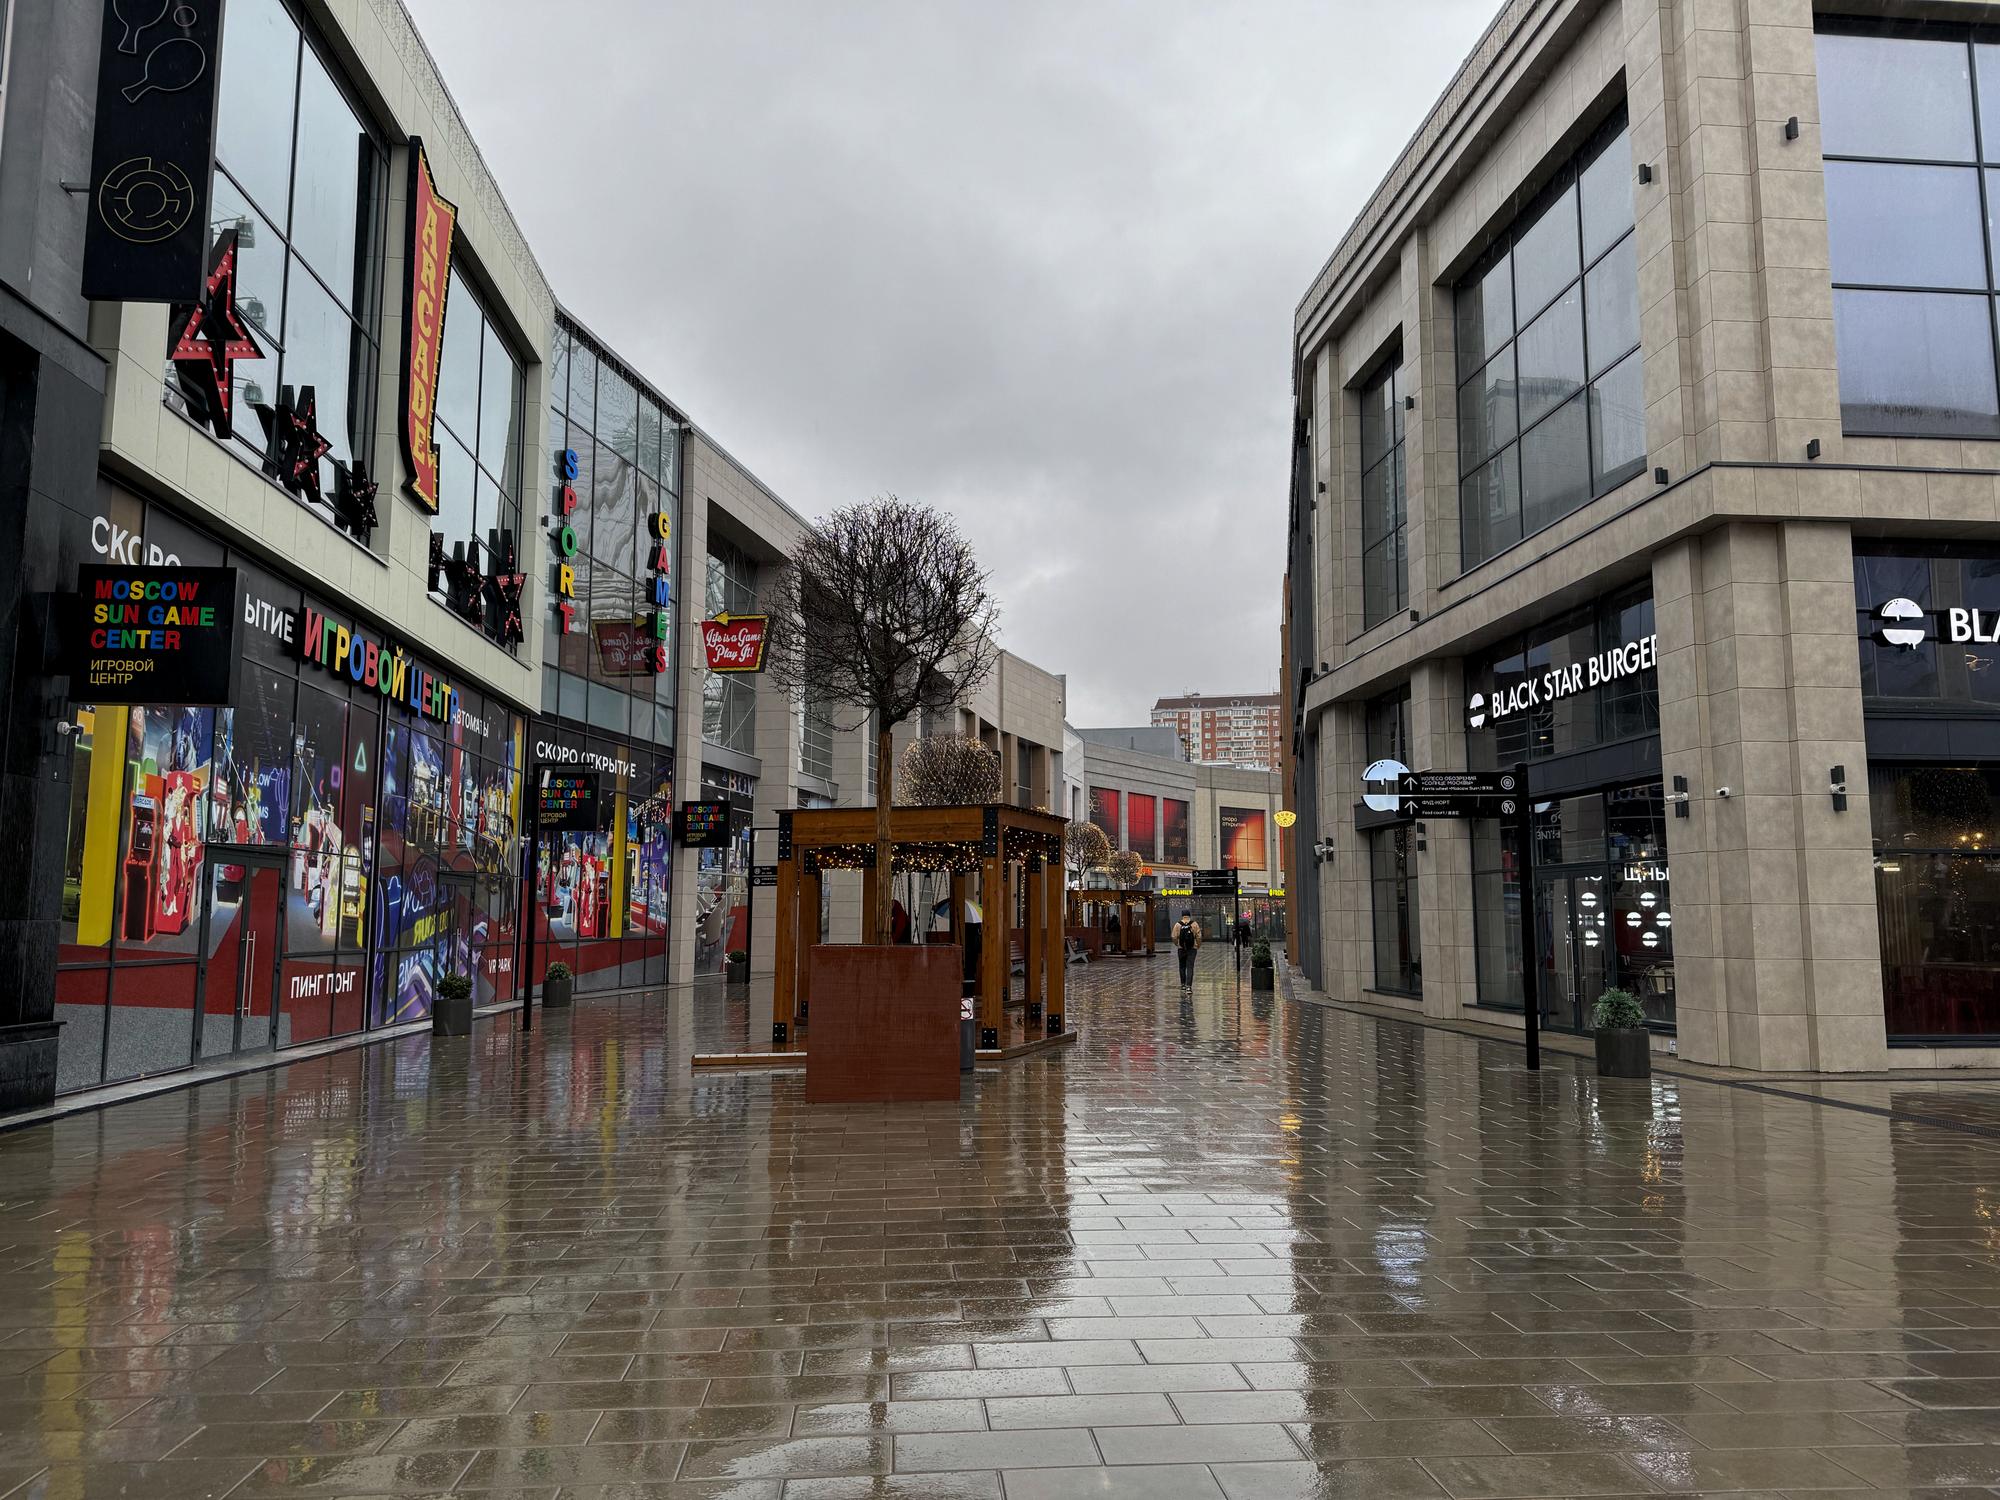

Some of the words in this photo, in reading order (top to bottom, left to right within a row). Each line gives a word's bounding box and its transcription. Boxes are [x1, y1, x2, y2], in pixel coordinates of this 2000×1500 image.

[412, 201, 438, 465] ARCADE
[560, 448, 578, 635] SPORT
[95, 579, 199, 601] MOSCOW
[655, 511, 671, 673] GAMES
[94, 603, 140, 624] SUN
[147, 605, 215, 626] GAME
[1949, 607, 2000, 643] BL
[90, 629, 181, 650] CENTER
[706, 628, 722, 648] Life
[738, 627, 761, 647] Game
[712, 643, 738, 663] Play
[739, 643, 755, 663] It!
[91, 658, 154, 672] ИГРОВОЙ
[303, 607, 406, 702] ИГРОВОЙ
[410, 665, 460, 725] ЦЕНТР
[89, 672, 133, 685] ЦЕНТР
[1492, 677, 1540, 719] BLACK
[1543, 663, 1584, 701] STAR
[536, 741, 578, 764] СКОРО
[581, 751, 637, 778] ОТКРЫТИЕ
[541, 789, 561, 798] SUN
[564, 789, 591, 799] GAME
[549, 779, 585, 788] OSCOW
[540, 799, 578, 809] CENTER
[290, 974, 325, 999] ПИНГ
[325, 971, 357, 995] ПОНГ
